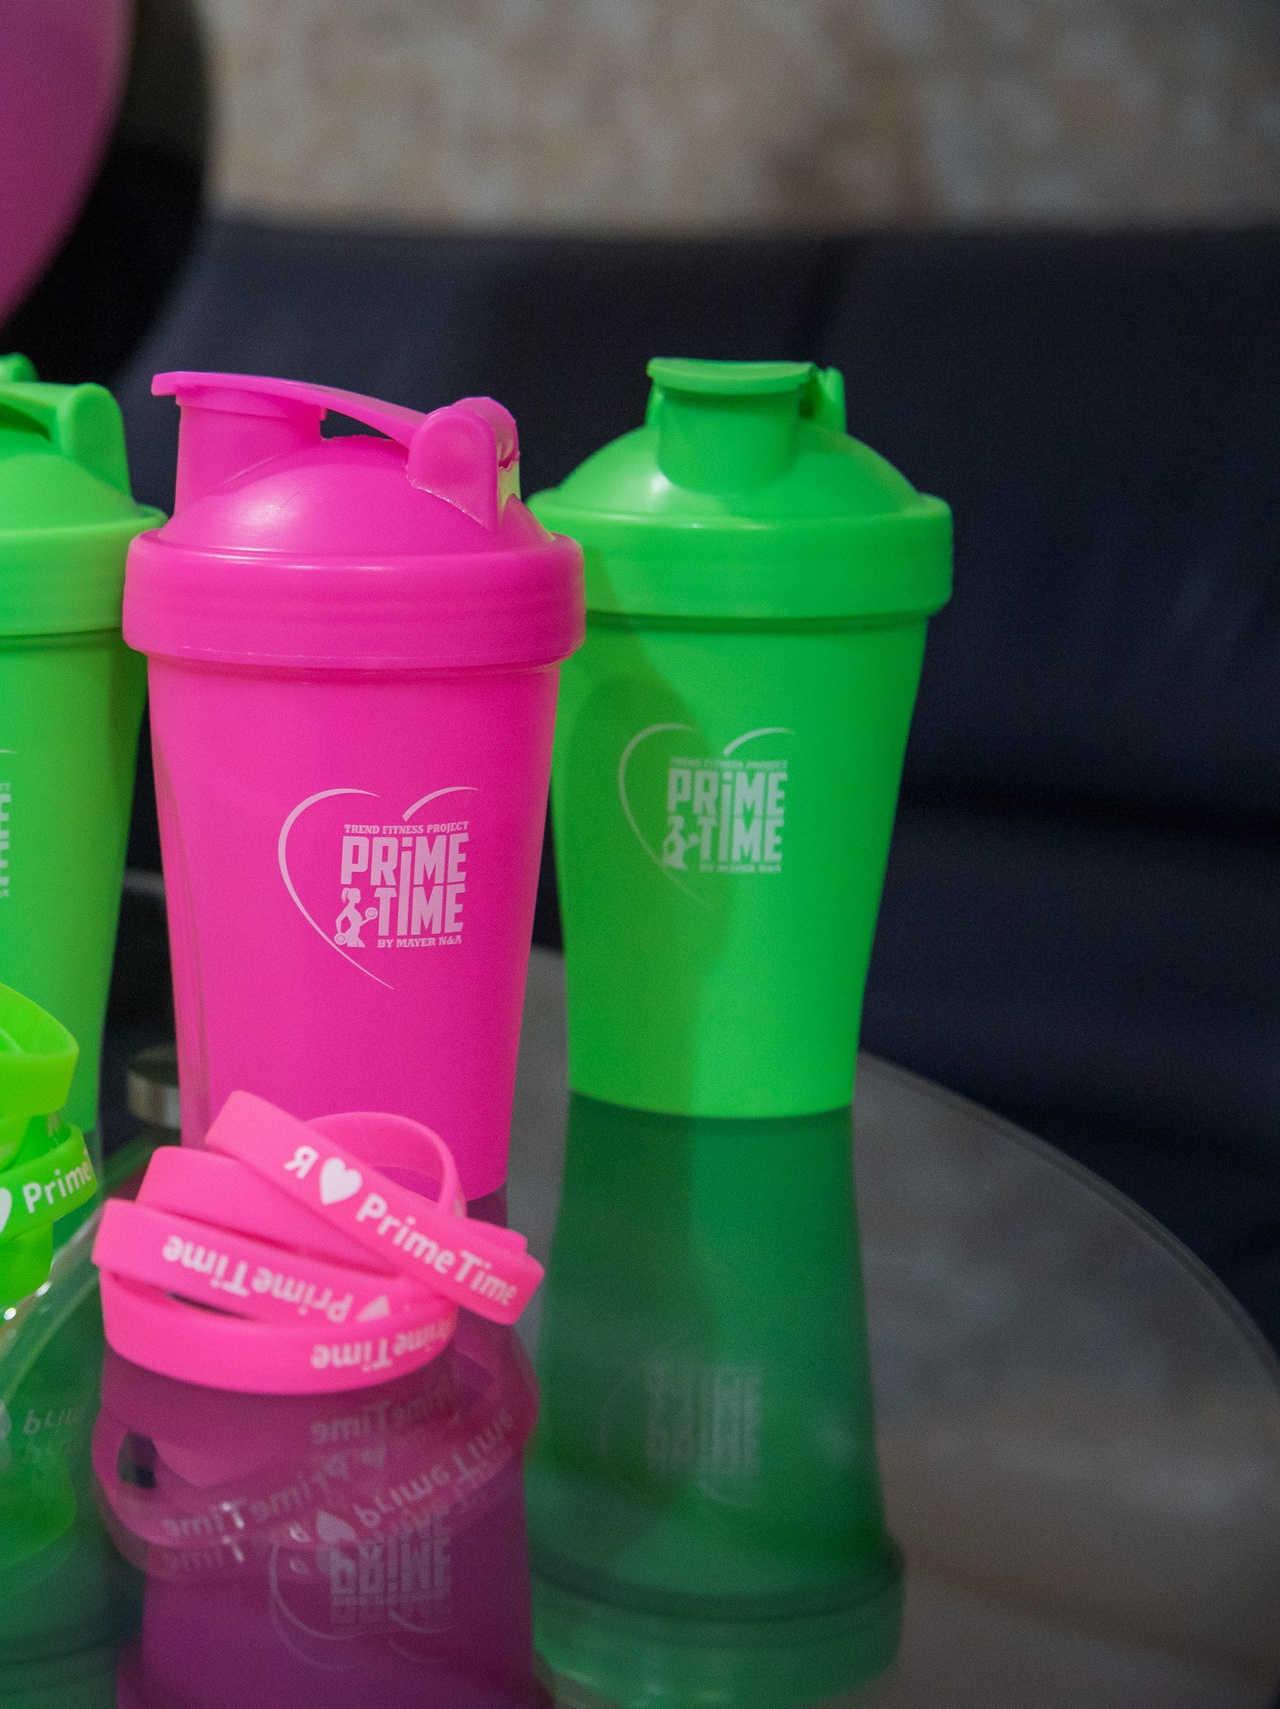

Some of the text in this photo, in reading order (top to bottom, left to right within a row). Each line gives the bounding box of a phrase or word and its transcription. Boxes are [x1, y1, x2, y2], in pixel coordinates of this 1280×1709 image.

[344, 821, 469, 835] TREND FITNESS PROJECT
[697, 816, 785, 863] TIME
[374, 883, 466, 936] TIME
[377, 935, 462, 949] BY MAYER N&A
[284, 1146, 520, 1308] Я PrimeTime
[161, 1235, 354, 1324] PrimeTime
